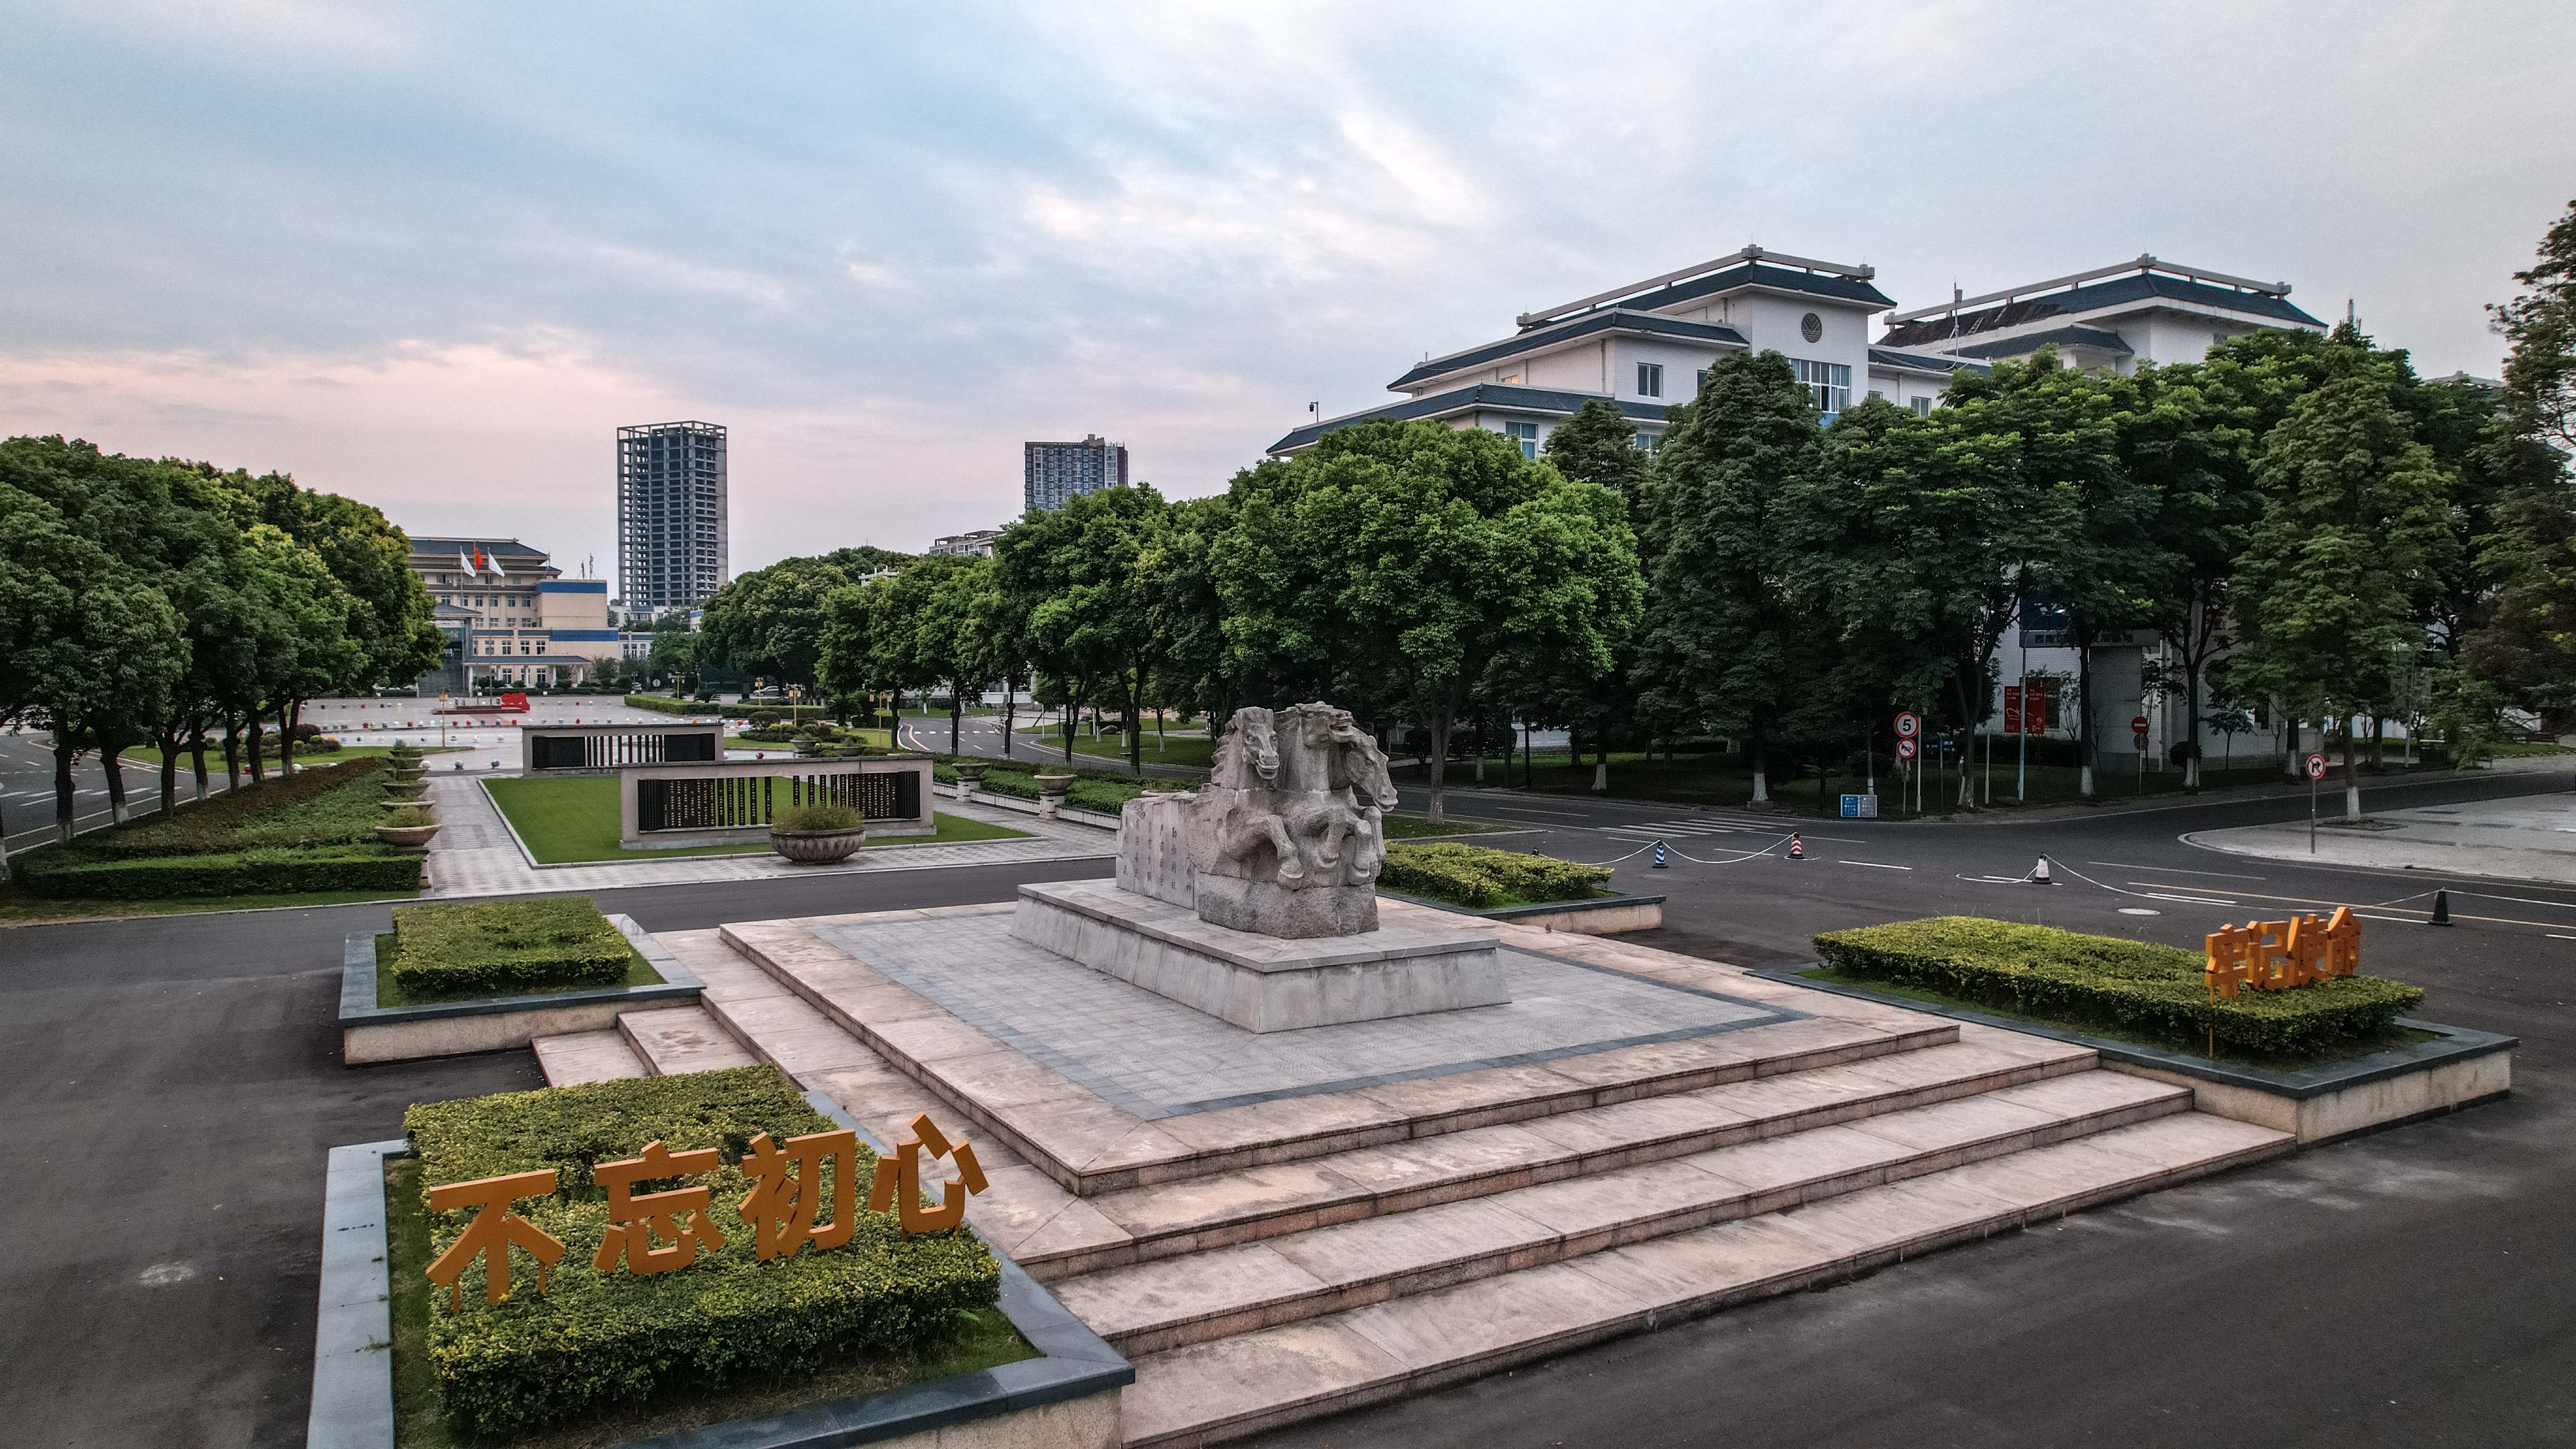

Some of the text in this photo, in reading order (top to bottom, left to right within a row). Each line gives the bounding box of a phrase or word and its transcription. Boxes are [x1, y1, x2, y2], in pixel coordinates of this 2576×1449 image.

[1903, 719, 1911, 732] 5
[2204, 906, 2363, 998] 牢记使命
[425, 1111, 989, 1306] 不忘初心
